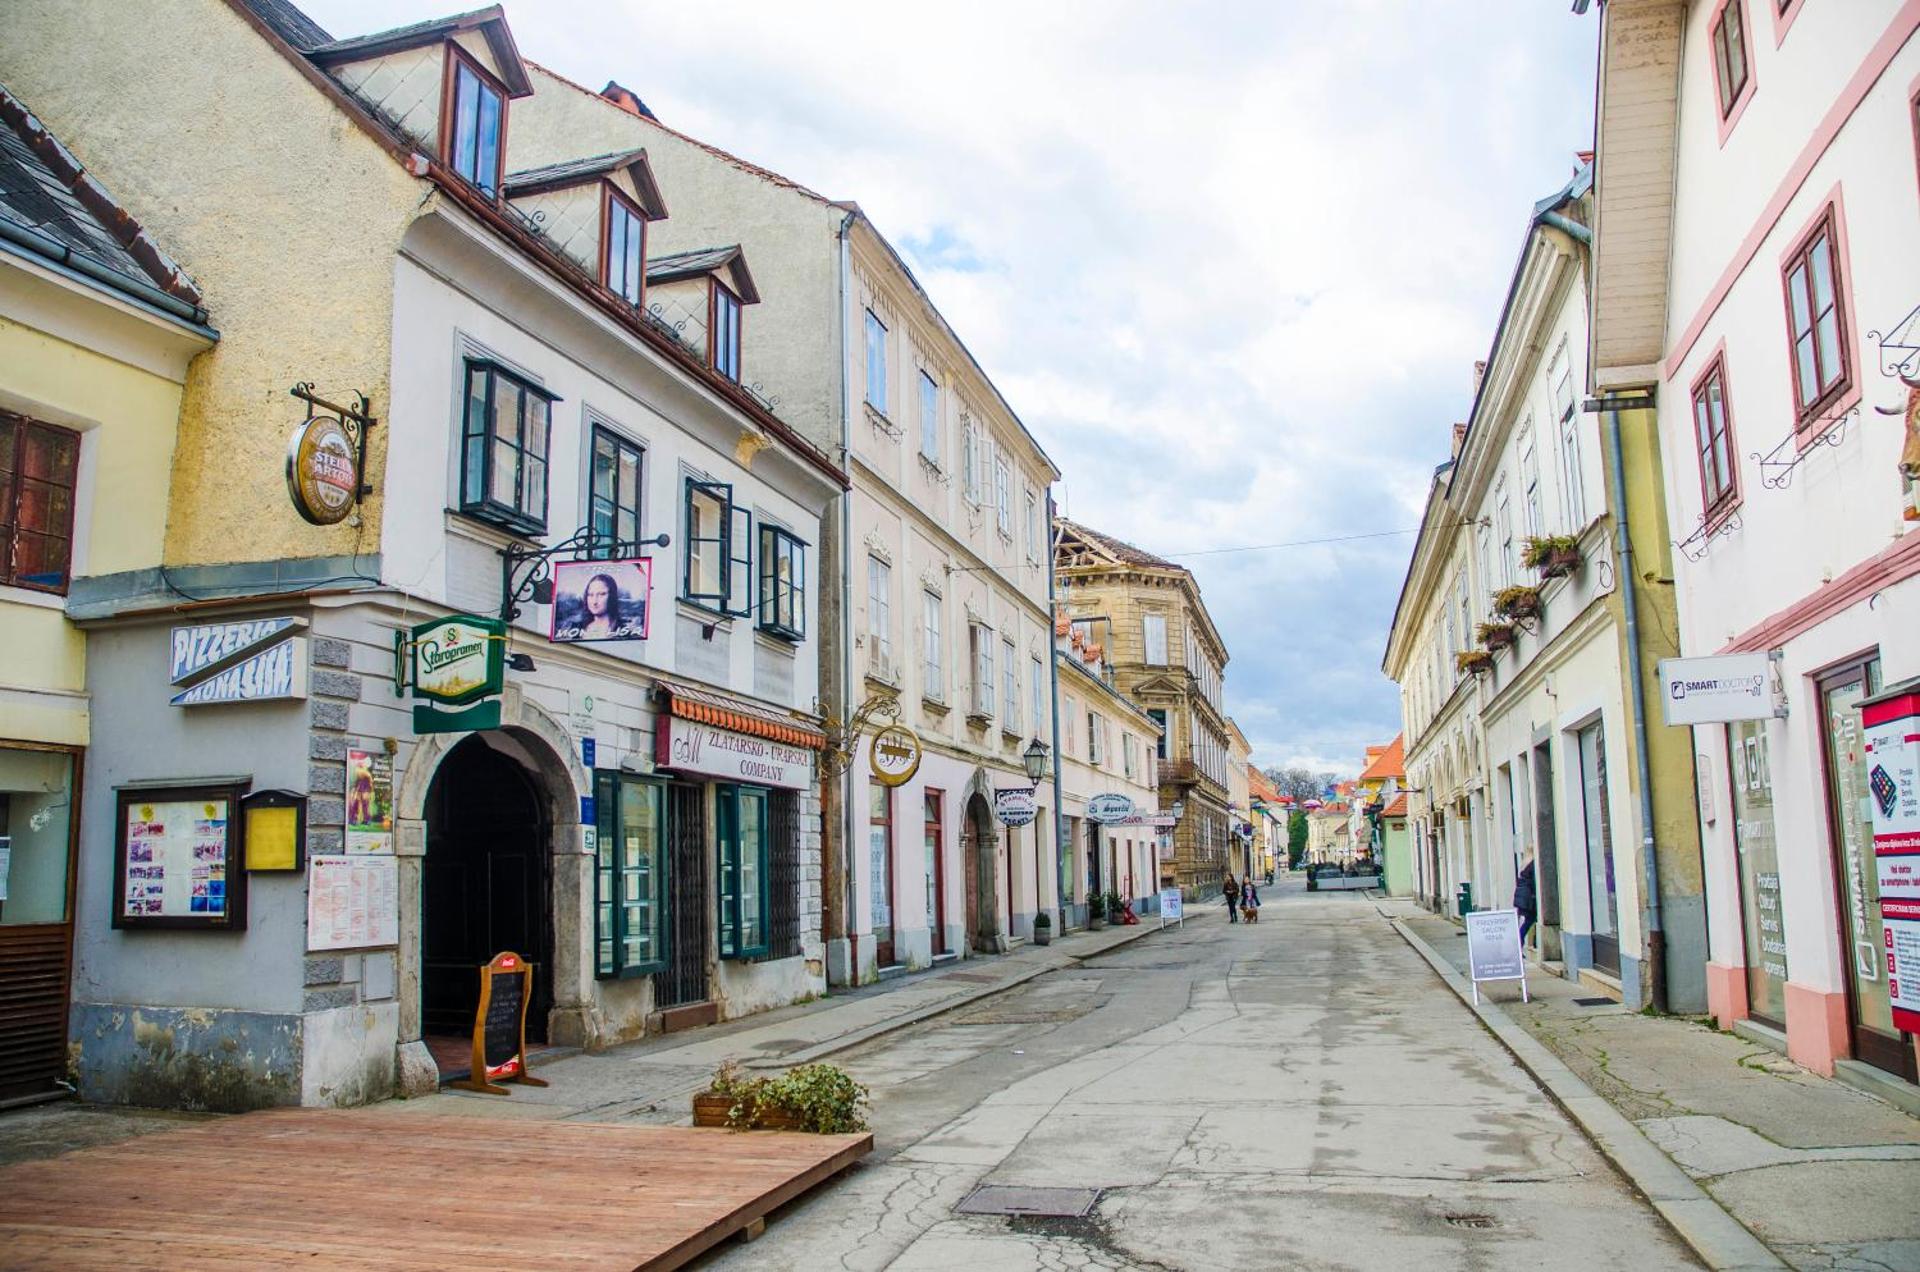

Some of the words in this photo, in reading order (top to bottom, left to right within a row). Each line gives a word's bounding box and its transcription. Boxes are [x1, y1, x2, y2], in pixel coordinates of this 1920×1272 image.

[172, 620, 278, 678] PIZZERIA
[421, 640, 485, 674] Staropramen
[708, 730, 764, 757] ZLATARSKO
[740, 759, 784, 781] COMPANY
